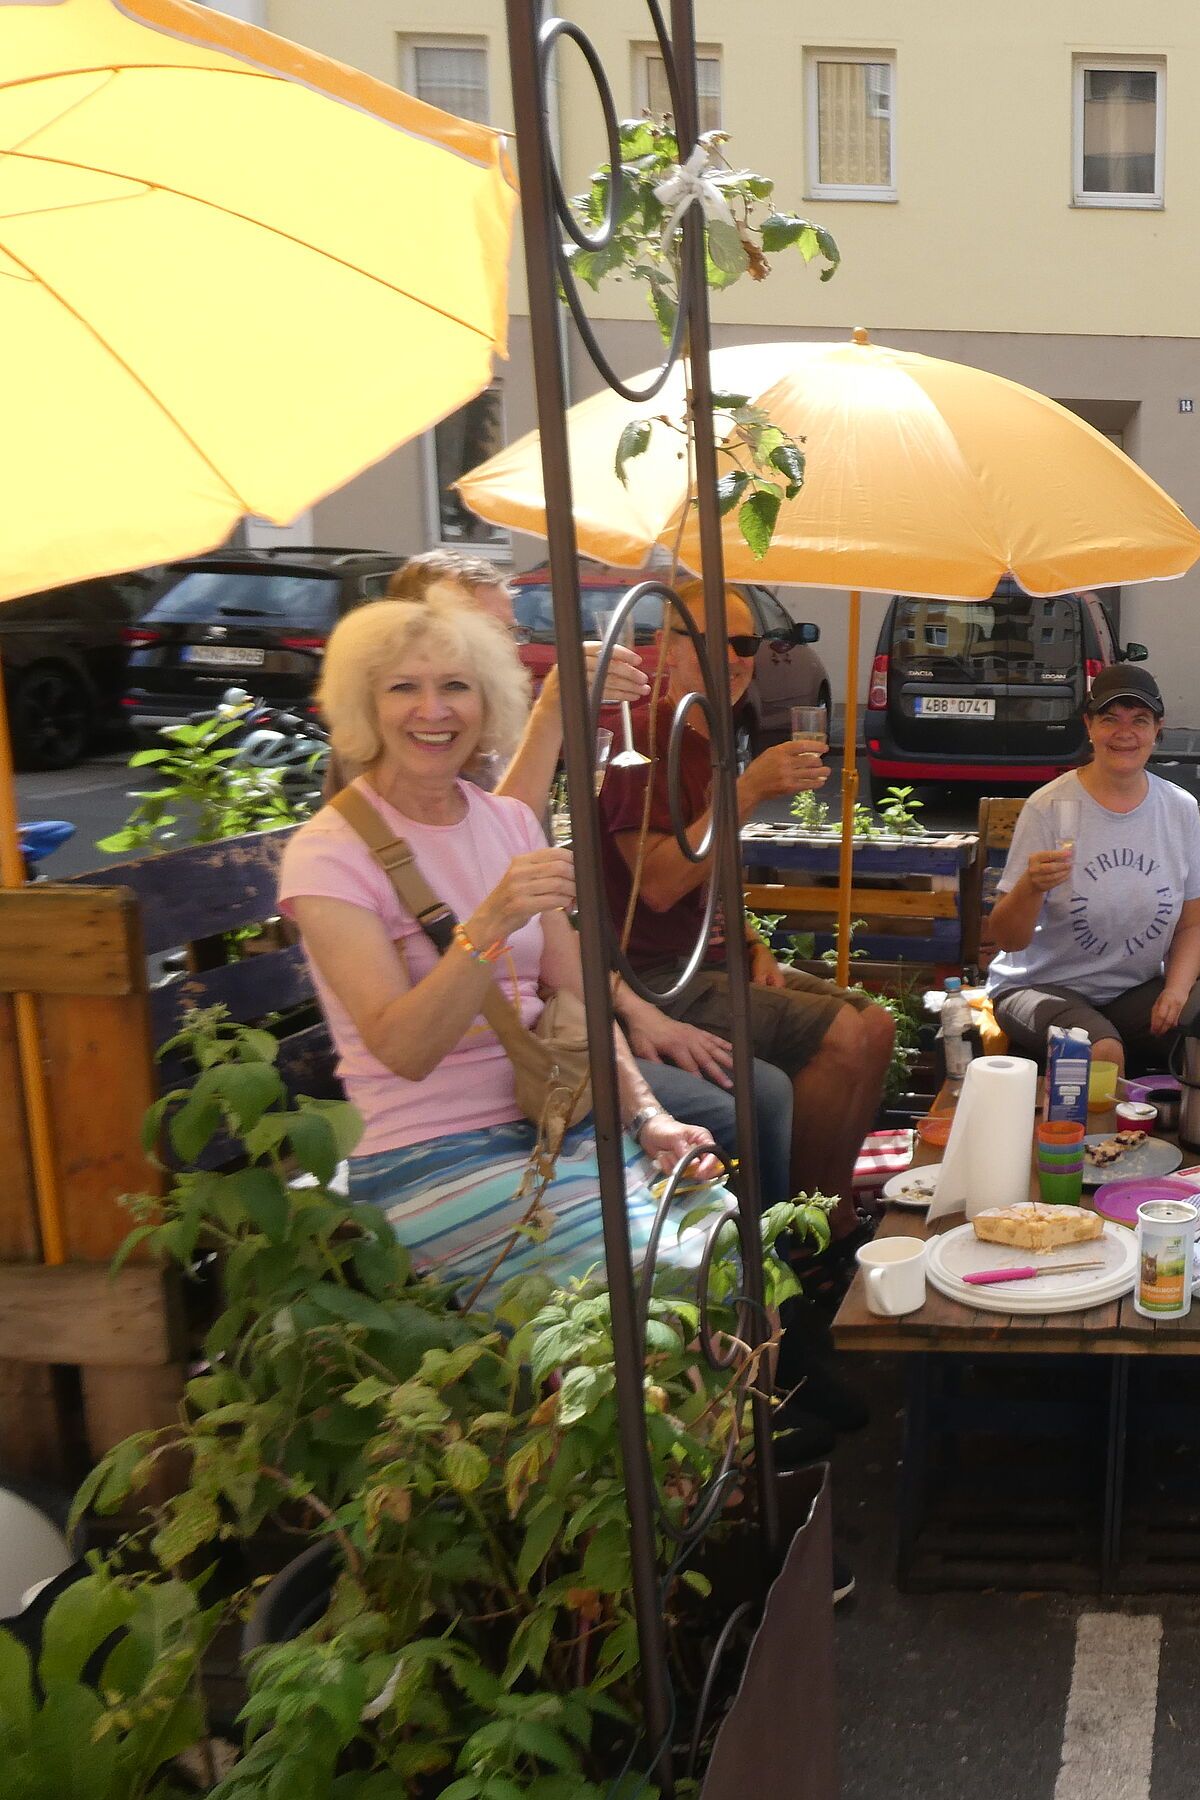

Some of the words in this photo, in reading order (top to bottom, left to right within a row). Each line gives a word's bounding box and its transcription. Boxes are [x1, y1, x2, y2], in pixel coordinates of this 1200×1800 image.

[1181, 400, 1192, 411] 14
[957, 700, 990, 714] 0741
[1084, 847, 1160, 881] FRIDAY
